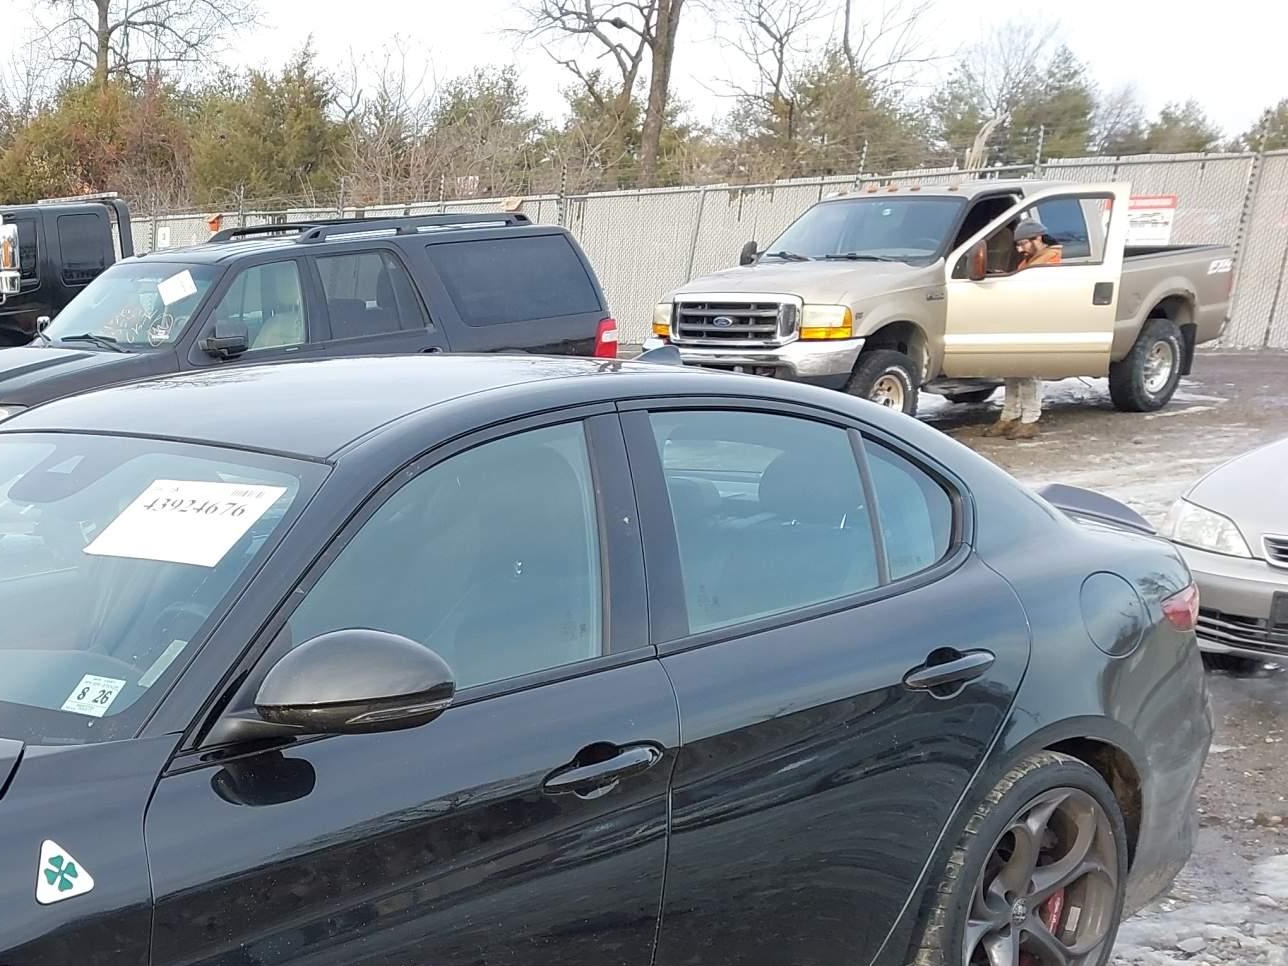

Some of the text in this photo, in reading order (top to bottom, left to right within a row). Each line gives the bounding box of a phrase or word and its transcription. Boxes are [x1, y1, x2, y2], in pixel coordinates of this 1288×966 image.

[143, 497, 247, 517] 43924676
[77, 686, 113, 705] 8 26
